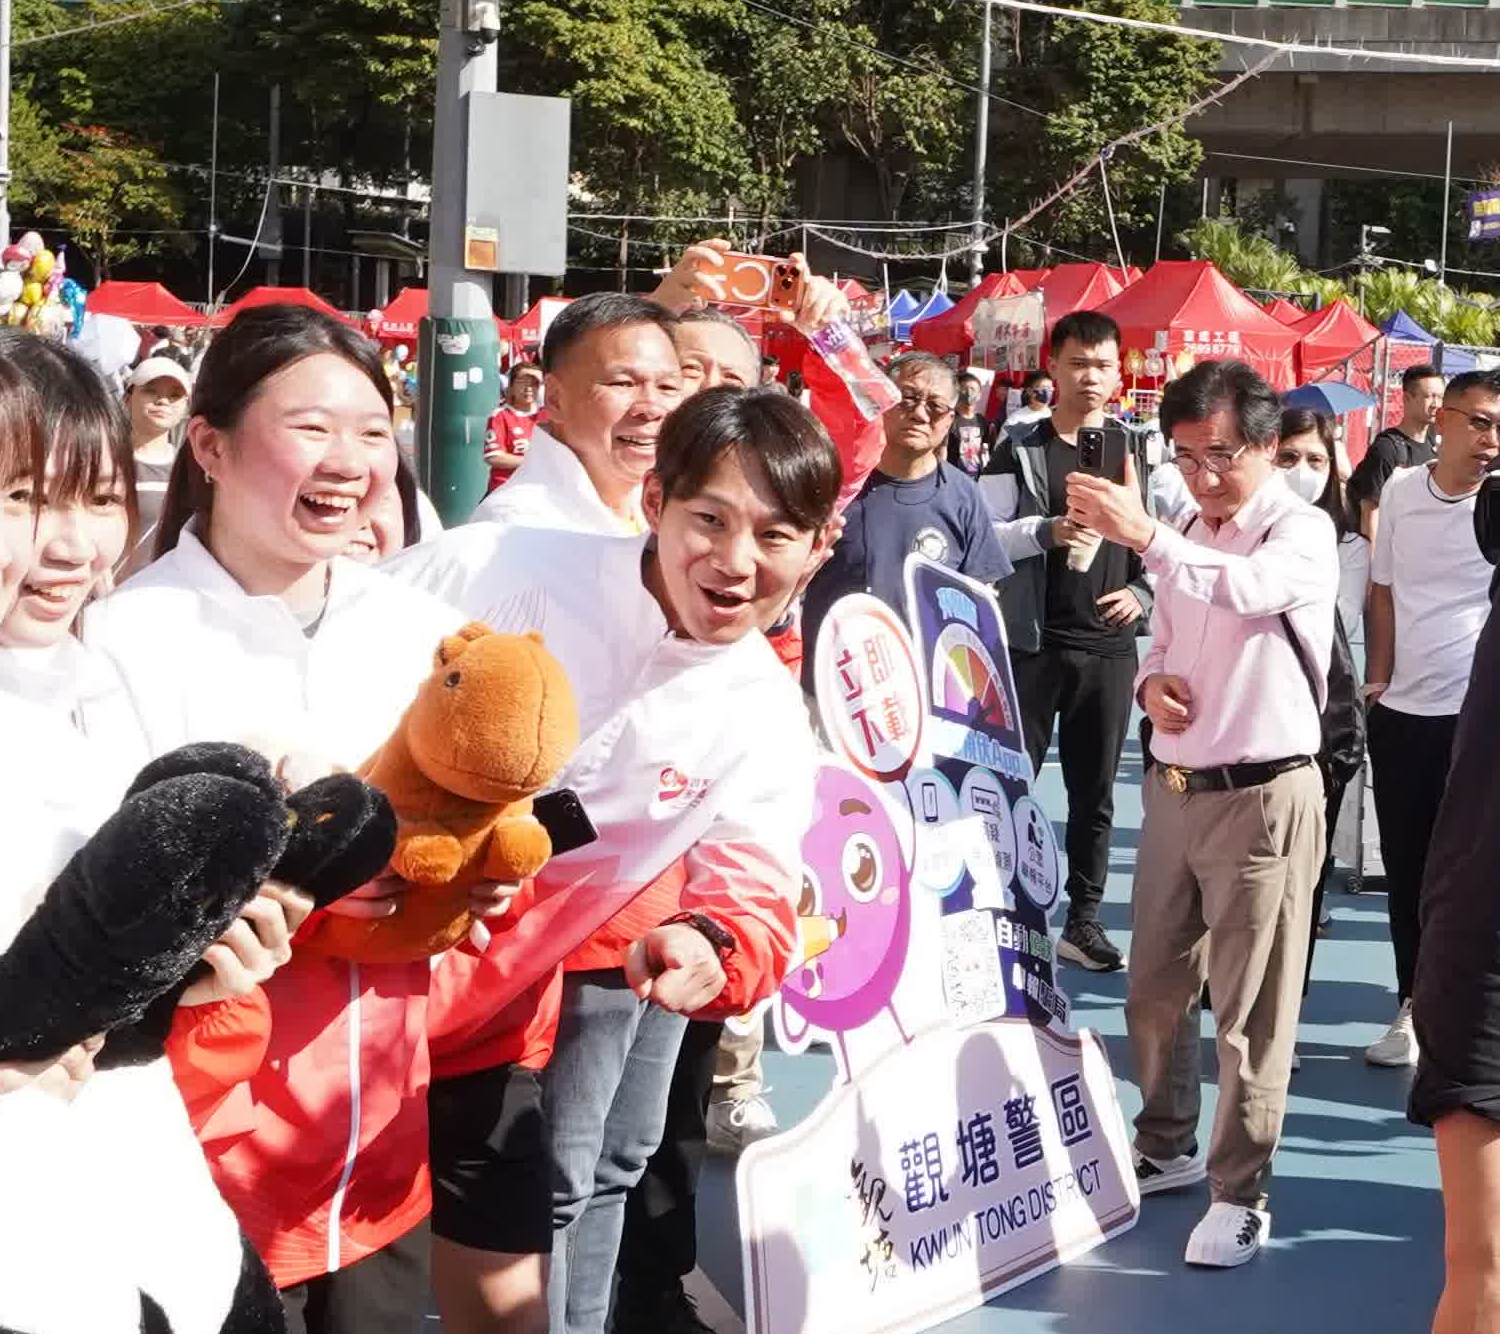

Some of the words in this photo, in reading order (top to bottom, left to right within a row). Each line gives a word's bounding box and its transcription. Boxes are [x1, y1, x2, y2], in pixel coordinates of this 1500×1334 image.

[836, 634, 895, 701] 立即
[898, 1072, 1093, 1214] 觀塘警區
[909, 1214, 973, 1272] KWUN
[974, 1199, 1027, 1246] TONG
[1028, 1158, 1102, 1222] DISTRICT
